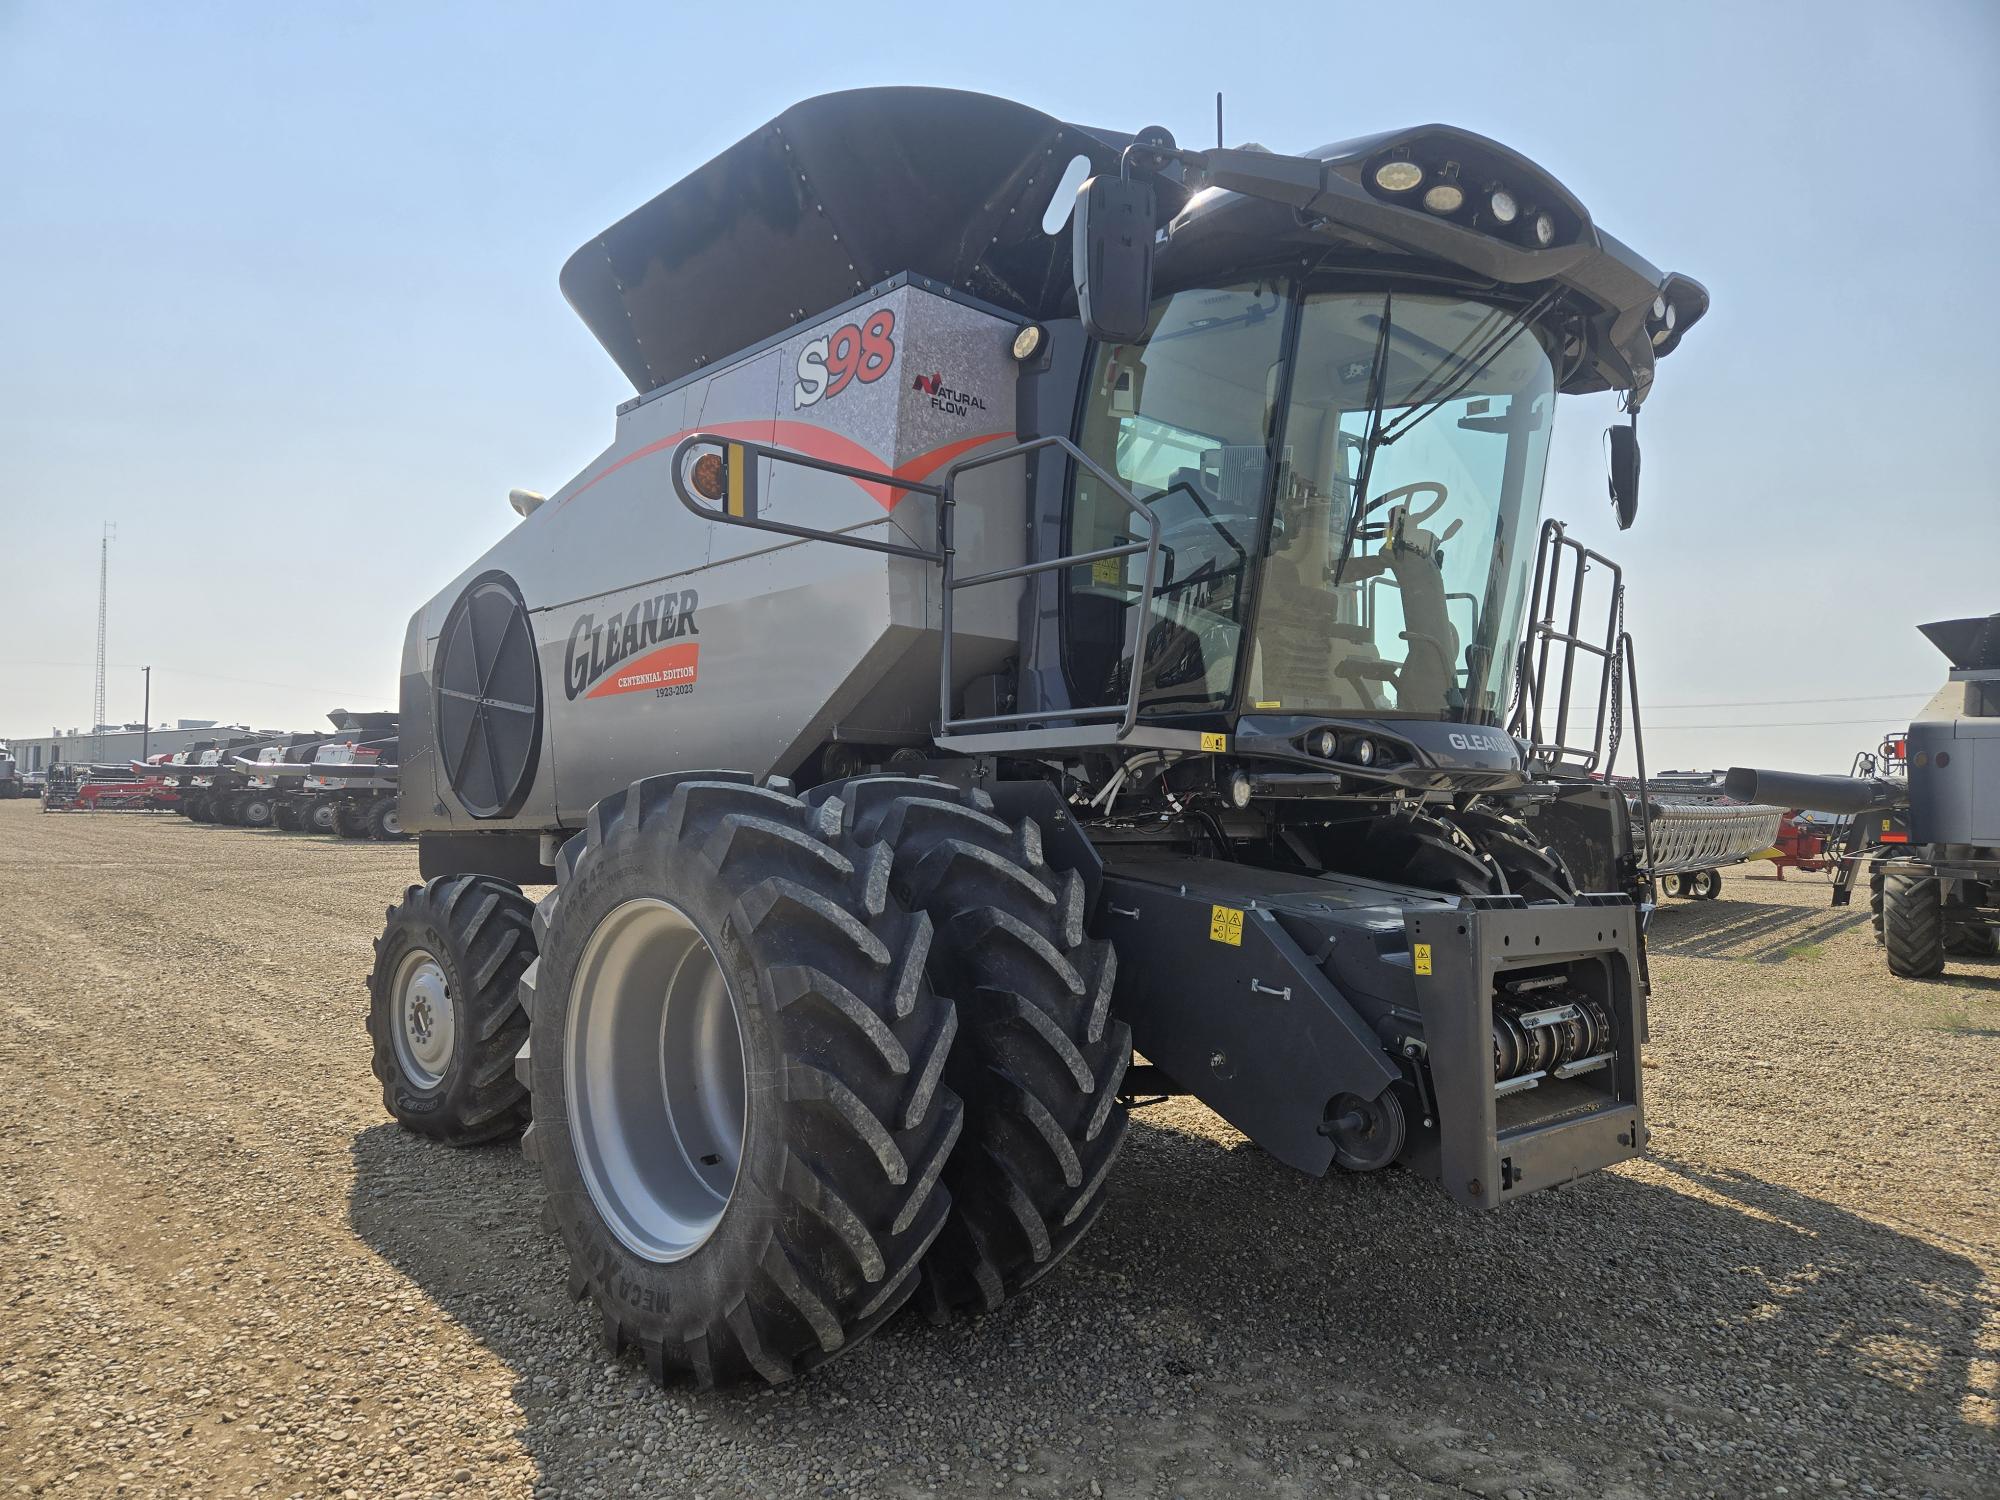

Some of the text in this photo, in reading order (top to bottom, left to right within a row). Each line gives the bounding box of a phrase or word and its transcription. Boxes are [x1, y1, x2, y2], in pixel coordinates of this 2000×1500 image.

[794, 308, 895, 411] S98
[912, 371, 986, 410] NATURAL
[931, 397, 967, 417] FLOW
[564, 588, 699, 701] GLEANER
[618, 665, 694, 687] CENTENNIAL EDITION
[656, 683, 693, 698] 1923-2023
